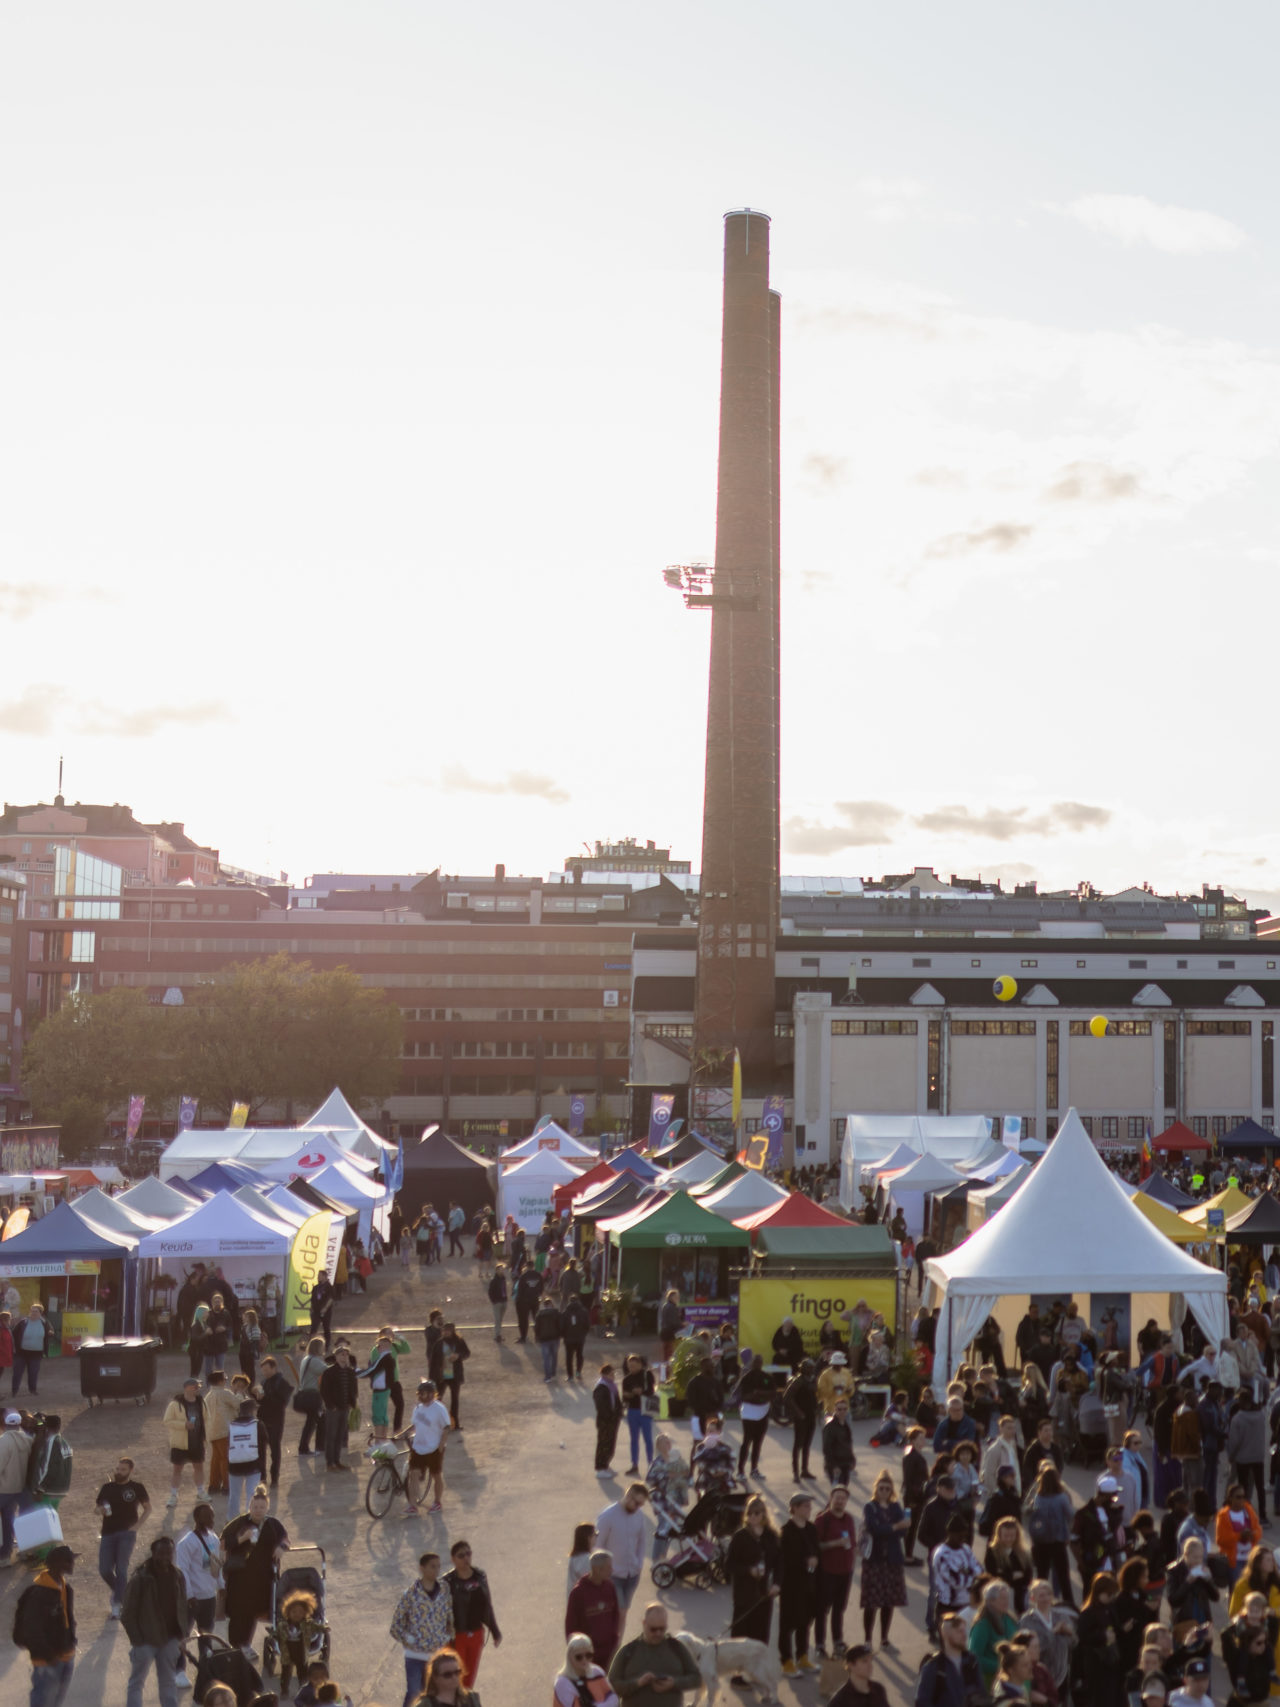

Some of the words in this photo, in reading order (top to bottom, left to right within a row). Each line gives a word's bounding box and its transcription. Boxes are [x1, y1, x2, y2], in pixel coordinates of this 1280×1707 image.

[160, 1242, 193, 1252] Keuda
[293, 1234, 321, 1311] Keuda
[790, 1293, 847, 1320] fingo
